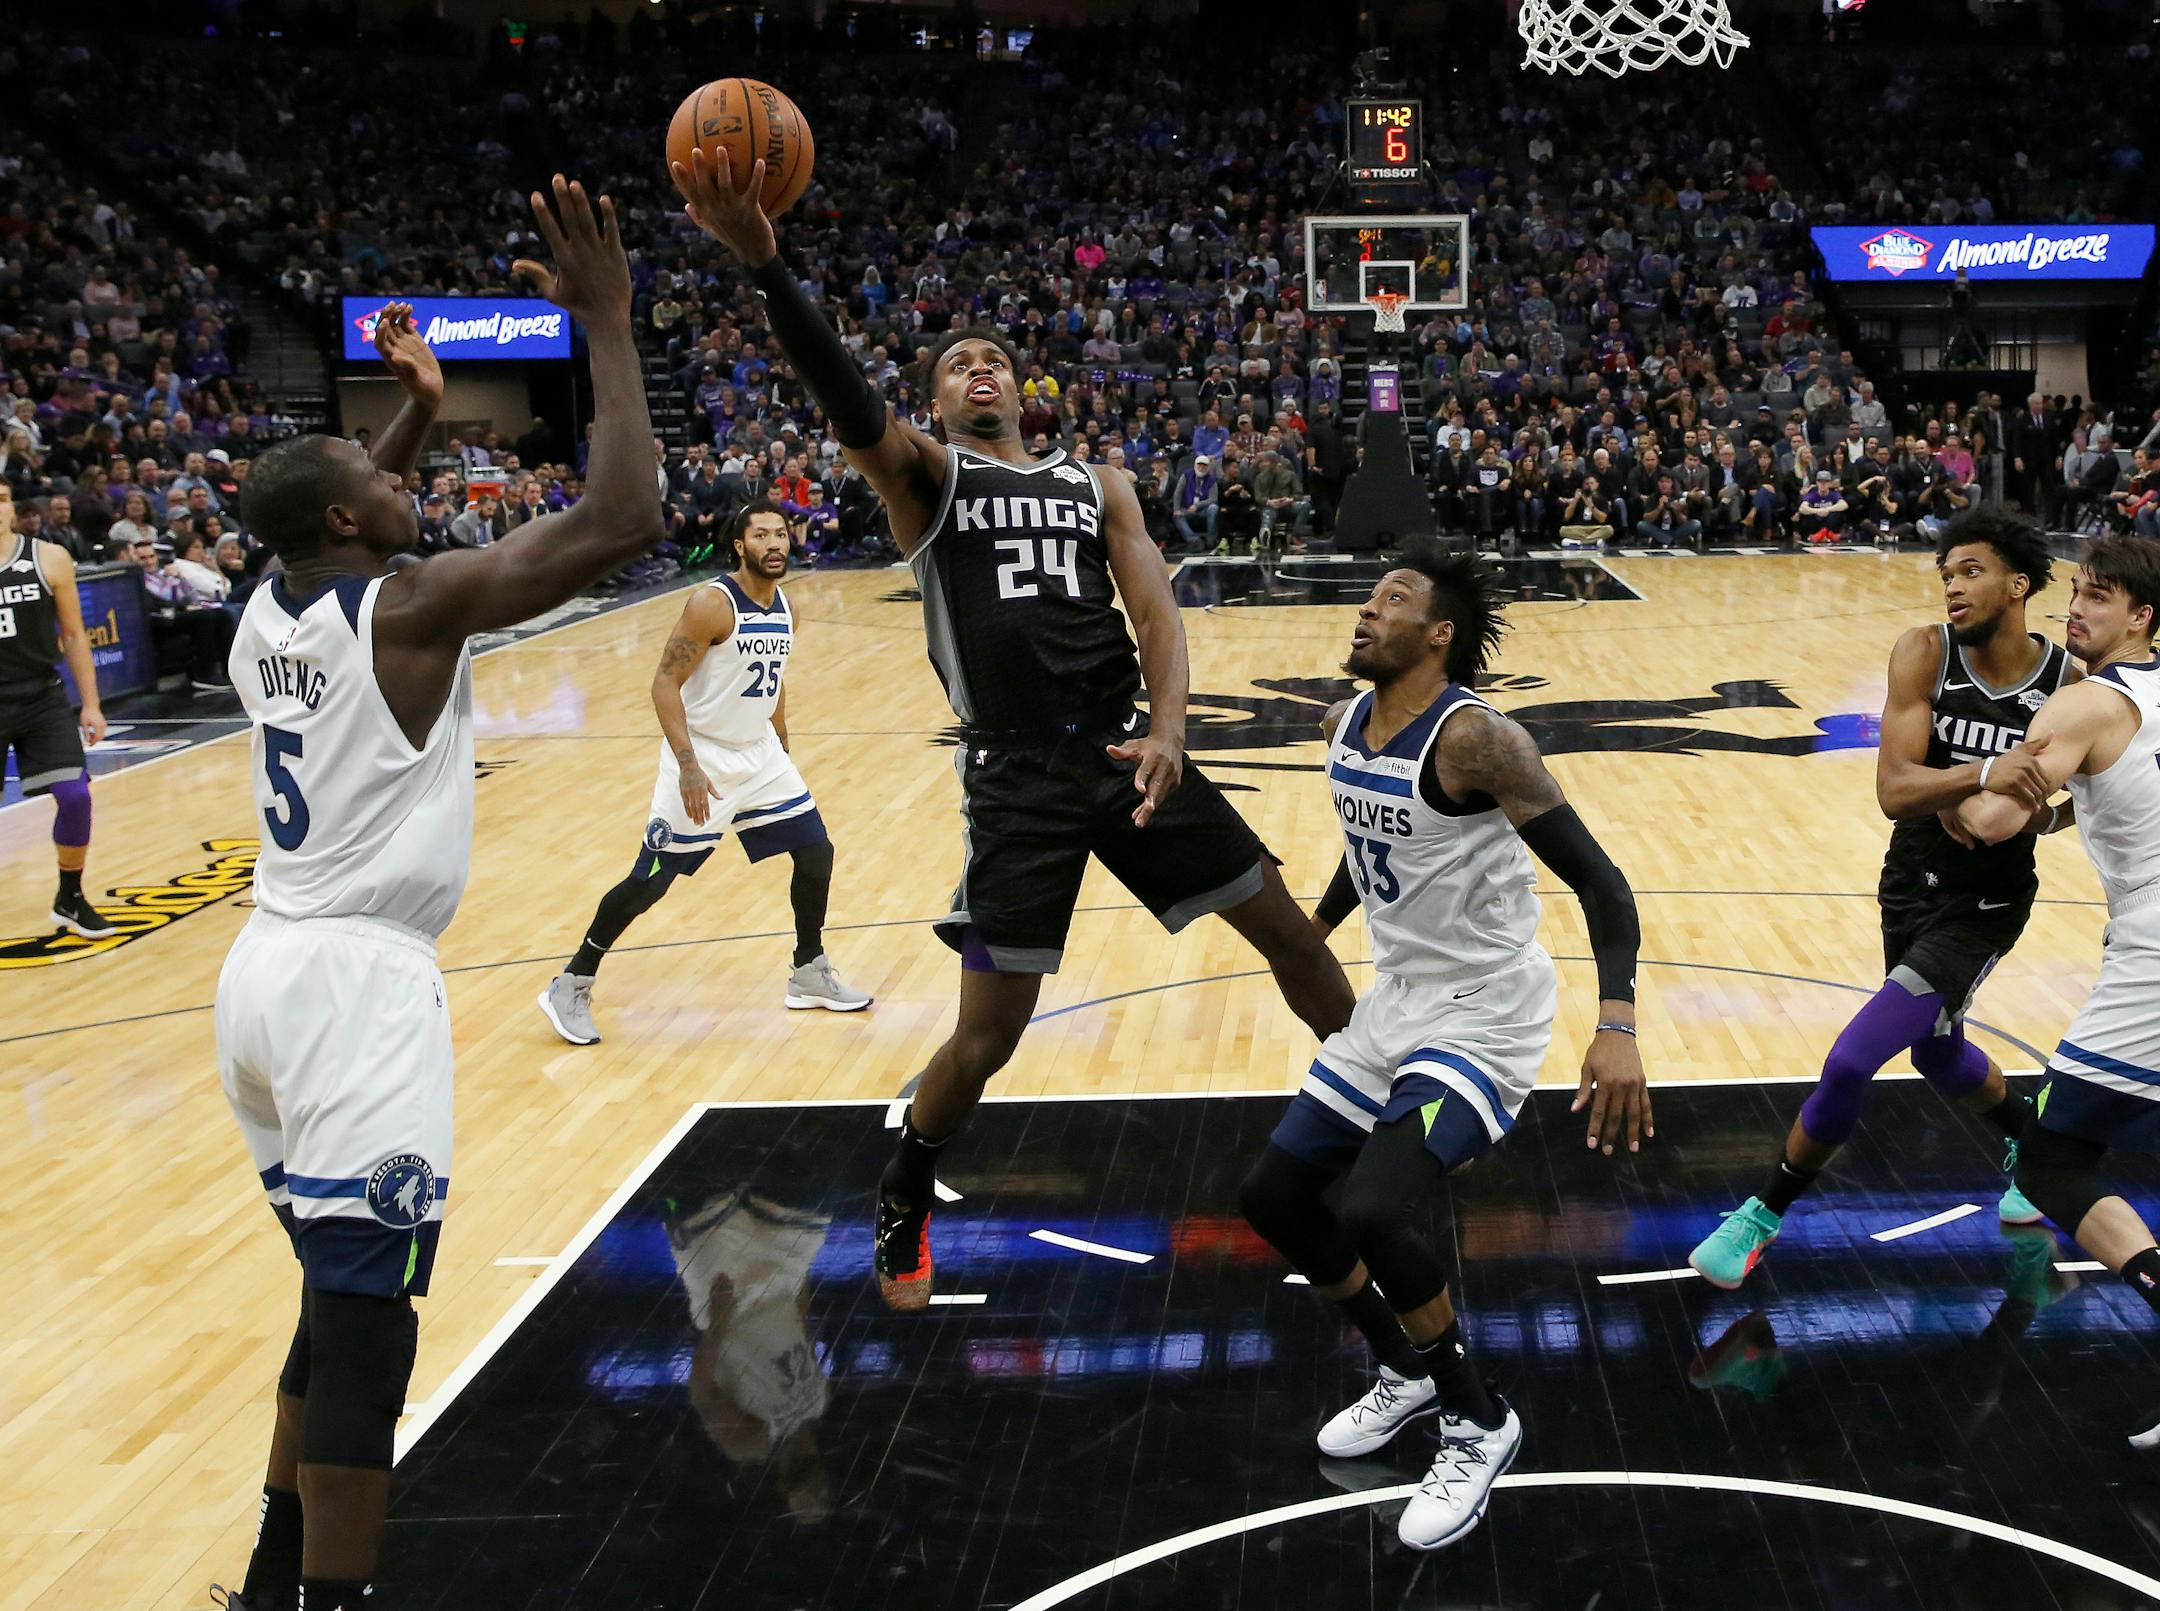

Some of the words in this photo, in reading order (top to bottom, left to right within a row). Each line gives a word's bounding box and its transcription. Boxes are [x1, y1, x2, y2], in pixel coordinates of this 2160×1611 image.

[751, 85, 784, 177] SPALDING
[1364, 106, 1412, 127] 11:42
[1386, 128, 1407, 162] 6
[1371, 168, 1418, 178] TISSOT
[1869, 243, 1924, 257] DIAMOND
[1883, 234, 1911, 247] BLUE
[1936, 233, 2034, 273] Almond
[2028, 233, 2110, 271] Breeze
[424, 312, 501, 345] Almond
[497, 313, 562, 345] Breeze
[955, 497, 1099, 538] KINGS
[995, 538, 1081, 599] 24
[736, 639, 791, 656] WOLVES
[258, 655, 327, 711] DIENG
[741, 660, 782, 697] 25
[1932, 711, 2025, 754] KING
[263, 723, 311, 852] 5
[1345, 830, 1399, 904] 33
